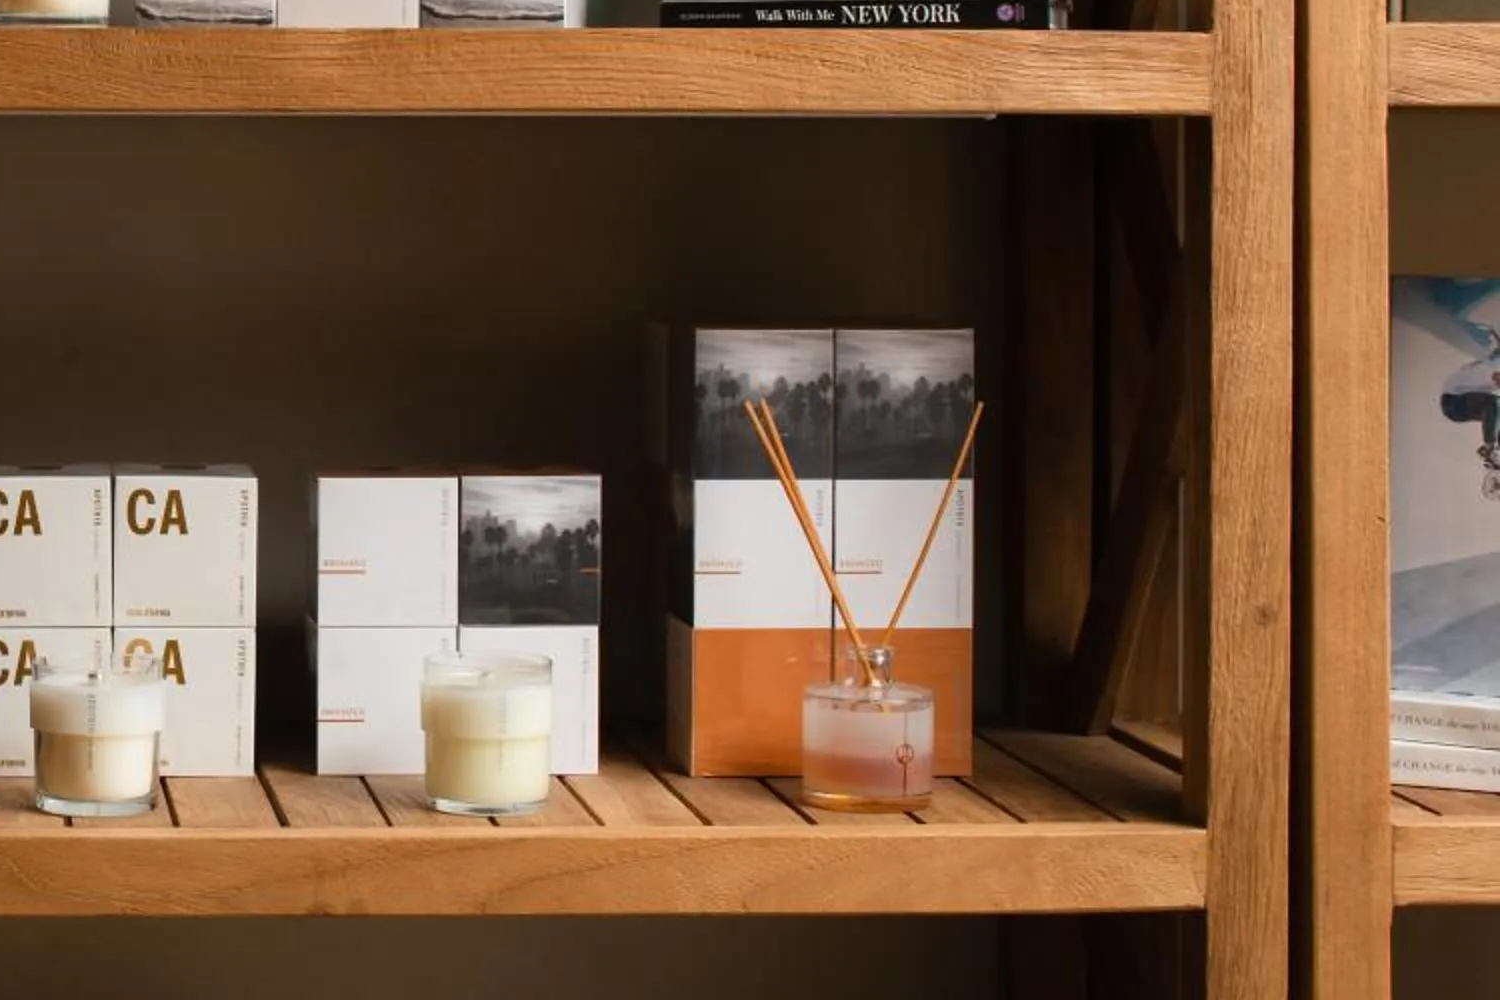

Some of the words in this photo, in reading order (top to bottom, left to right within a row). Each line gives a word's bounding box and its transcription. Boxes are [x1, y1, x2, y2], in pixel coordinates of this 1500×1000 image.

[755, 9, 783, 21] Walk
[787, 9, 814, 21] With
[816, 9, 835, 21] Me
[840, 5, 893, 24] NEW
[899, 3, 961, 23] YORK
[126, 488, 189, 536] CA
